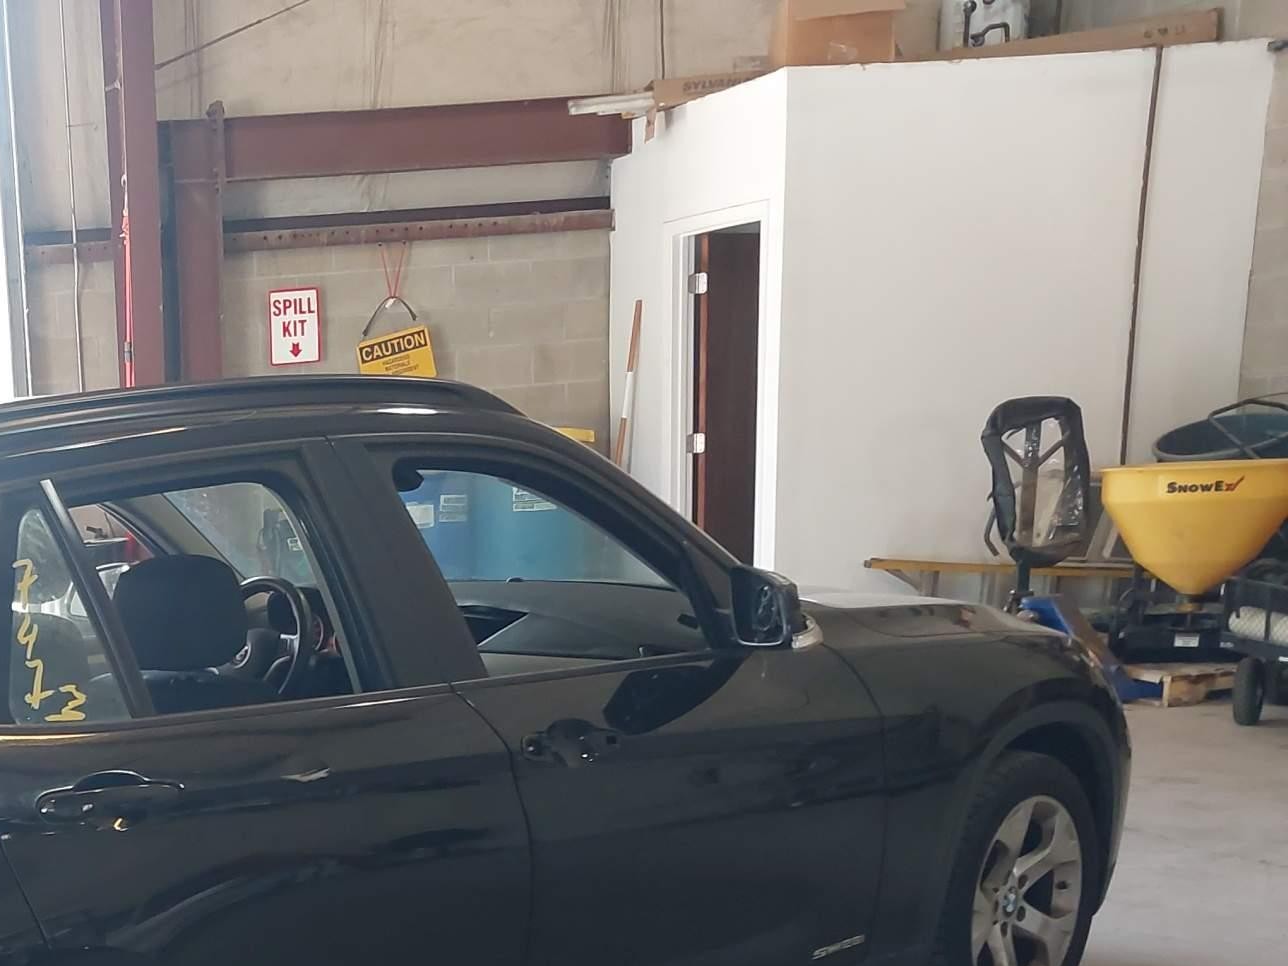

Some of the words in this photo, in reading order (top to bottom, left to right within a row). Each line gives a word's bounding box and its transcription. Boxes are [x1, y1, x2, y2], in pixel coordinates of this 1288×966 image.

[272, 296, 316, 317] SPILL
[282, 319, 308, 338] KIT
[361, 331, 427, 361] CAUTION
